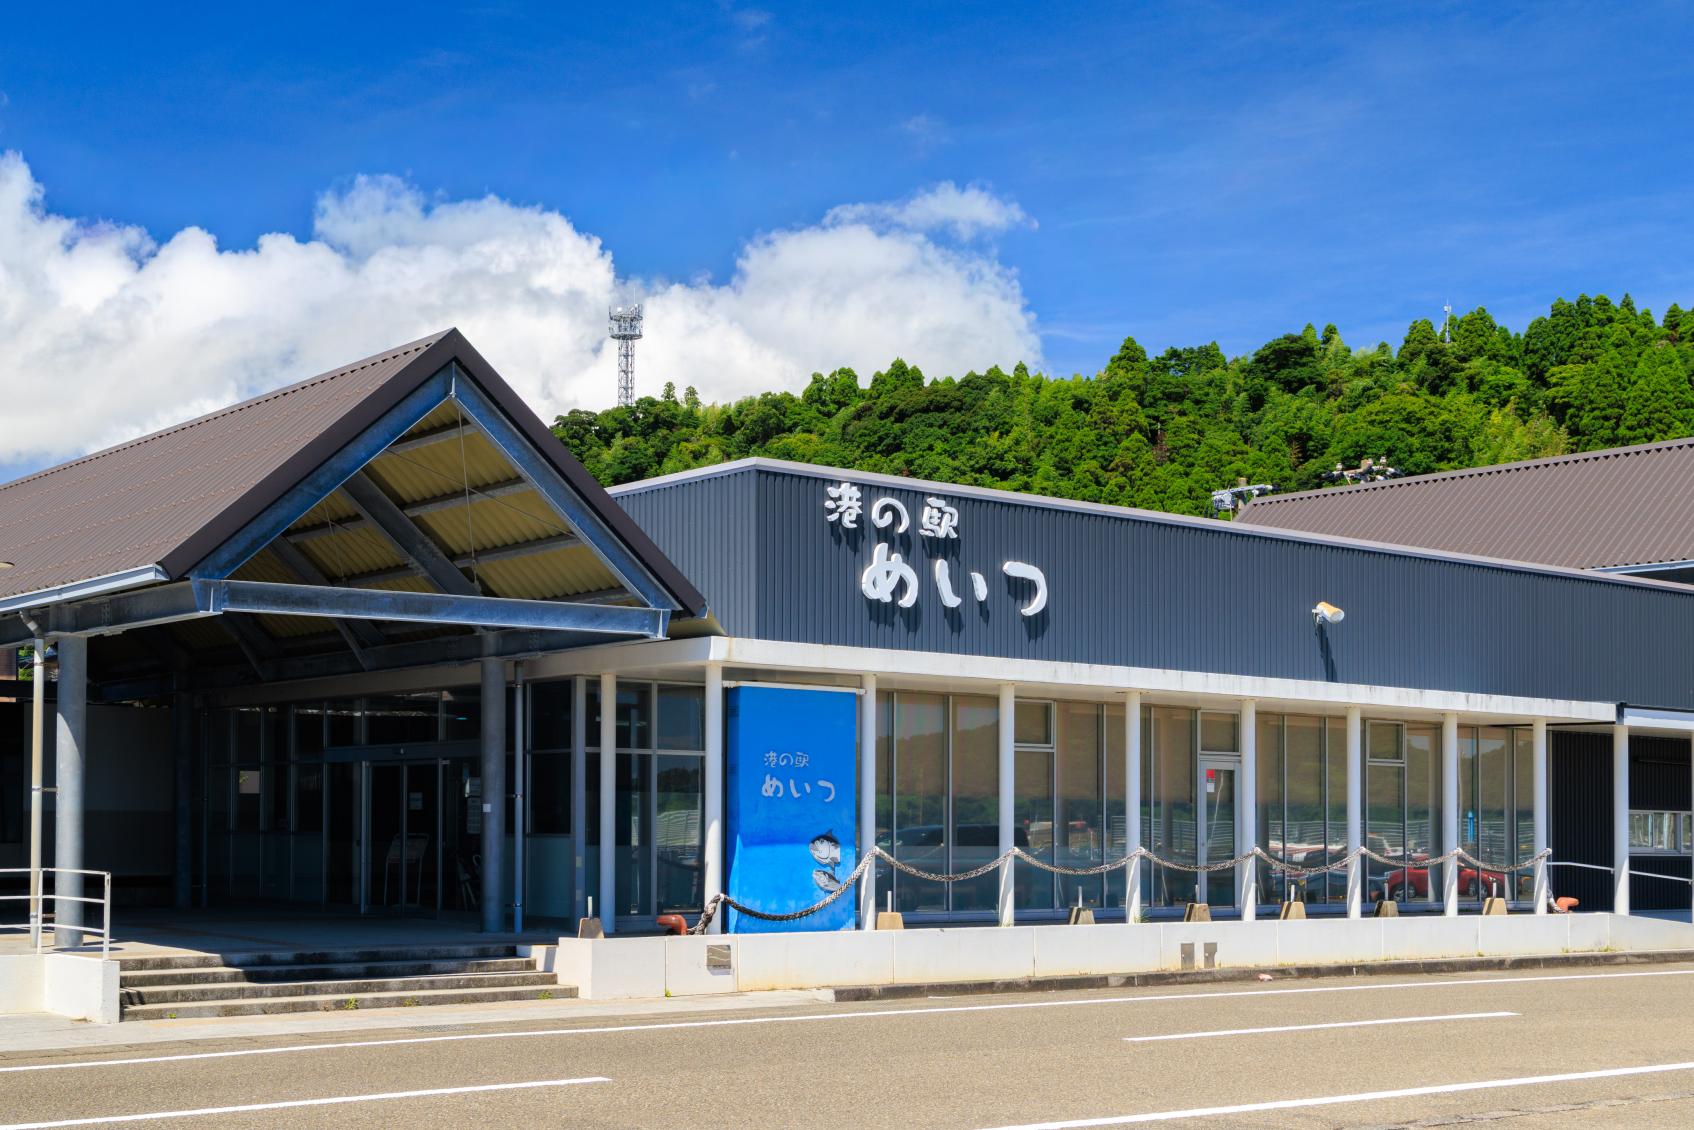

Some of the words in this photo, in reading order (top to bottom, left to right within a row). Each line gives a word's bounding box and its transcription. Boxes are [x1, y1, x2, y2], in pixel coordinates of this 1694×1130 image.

[825, 483, 958, 538] 港の駅
[862, 543, 1047, 616] めいつ
[764, 751, 809, 767] 港の駅
[762, 775, 835, 802] めいつ
